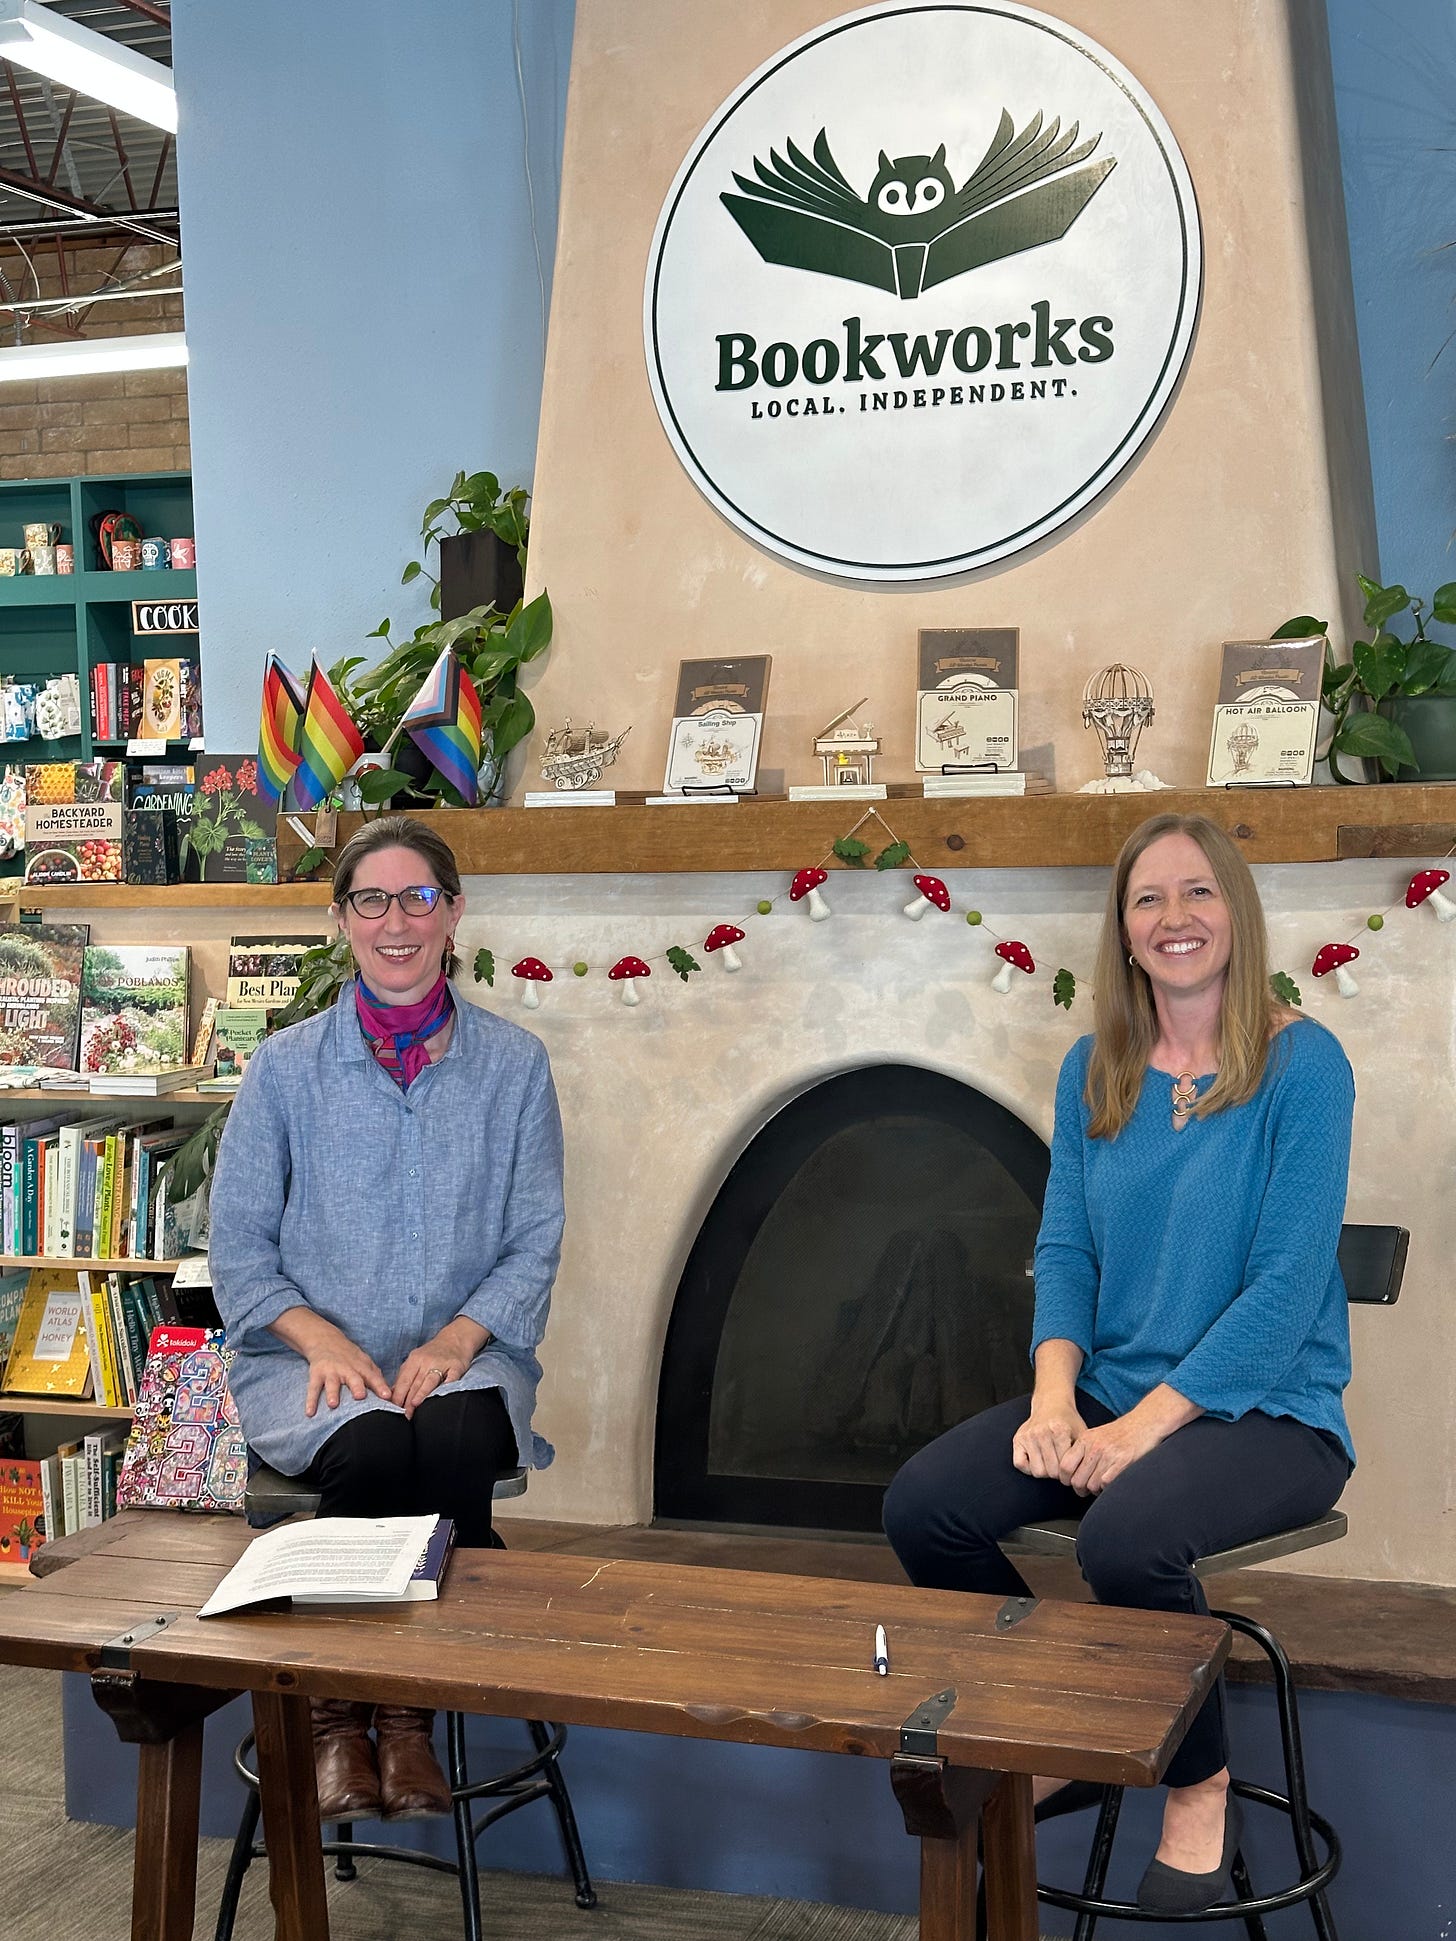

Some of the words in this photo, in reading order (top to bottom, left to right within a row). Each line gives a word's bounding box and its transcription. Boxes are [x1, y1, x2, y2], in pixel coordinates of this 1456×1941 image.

[714, 300, 1114, 392] Bookworks
[751, 397, 845, 419] LOCAL.
[859, 378, 1078, 411] INDEPENDENT.
[140, 604, 198, 630] COOK
[52, 807, 105, 818] BACKYARD
[36, 819, 113, 830] HOMESTEADER
[118, 977, 179, 987] POBLANOS
[240, 980, 265, 996] Best
[4, 1135, 16, 1188] bloom
[0, 1286, 28, 1307] OMPA
[48, 1306, 78, 1315] WORLD
[155, 1309, 164, 1321] and
[48, 1318, 72, 1326] ATLAS
[125, 1309, 138, 1332] Hello
[42, 1334, 72, 1342] HONEY
[129, 1333, 141, 1353] Tiny
[170, 1338, 197, 1347] tokidoki
[18, 1487, 37, 1496] NOT
[90, 1458, 102, 1517] Self-Sufficient
[3, 1496, 24, 1504] KILL
